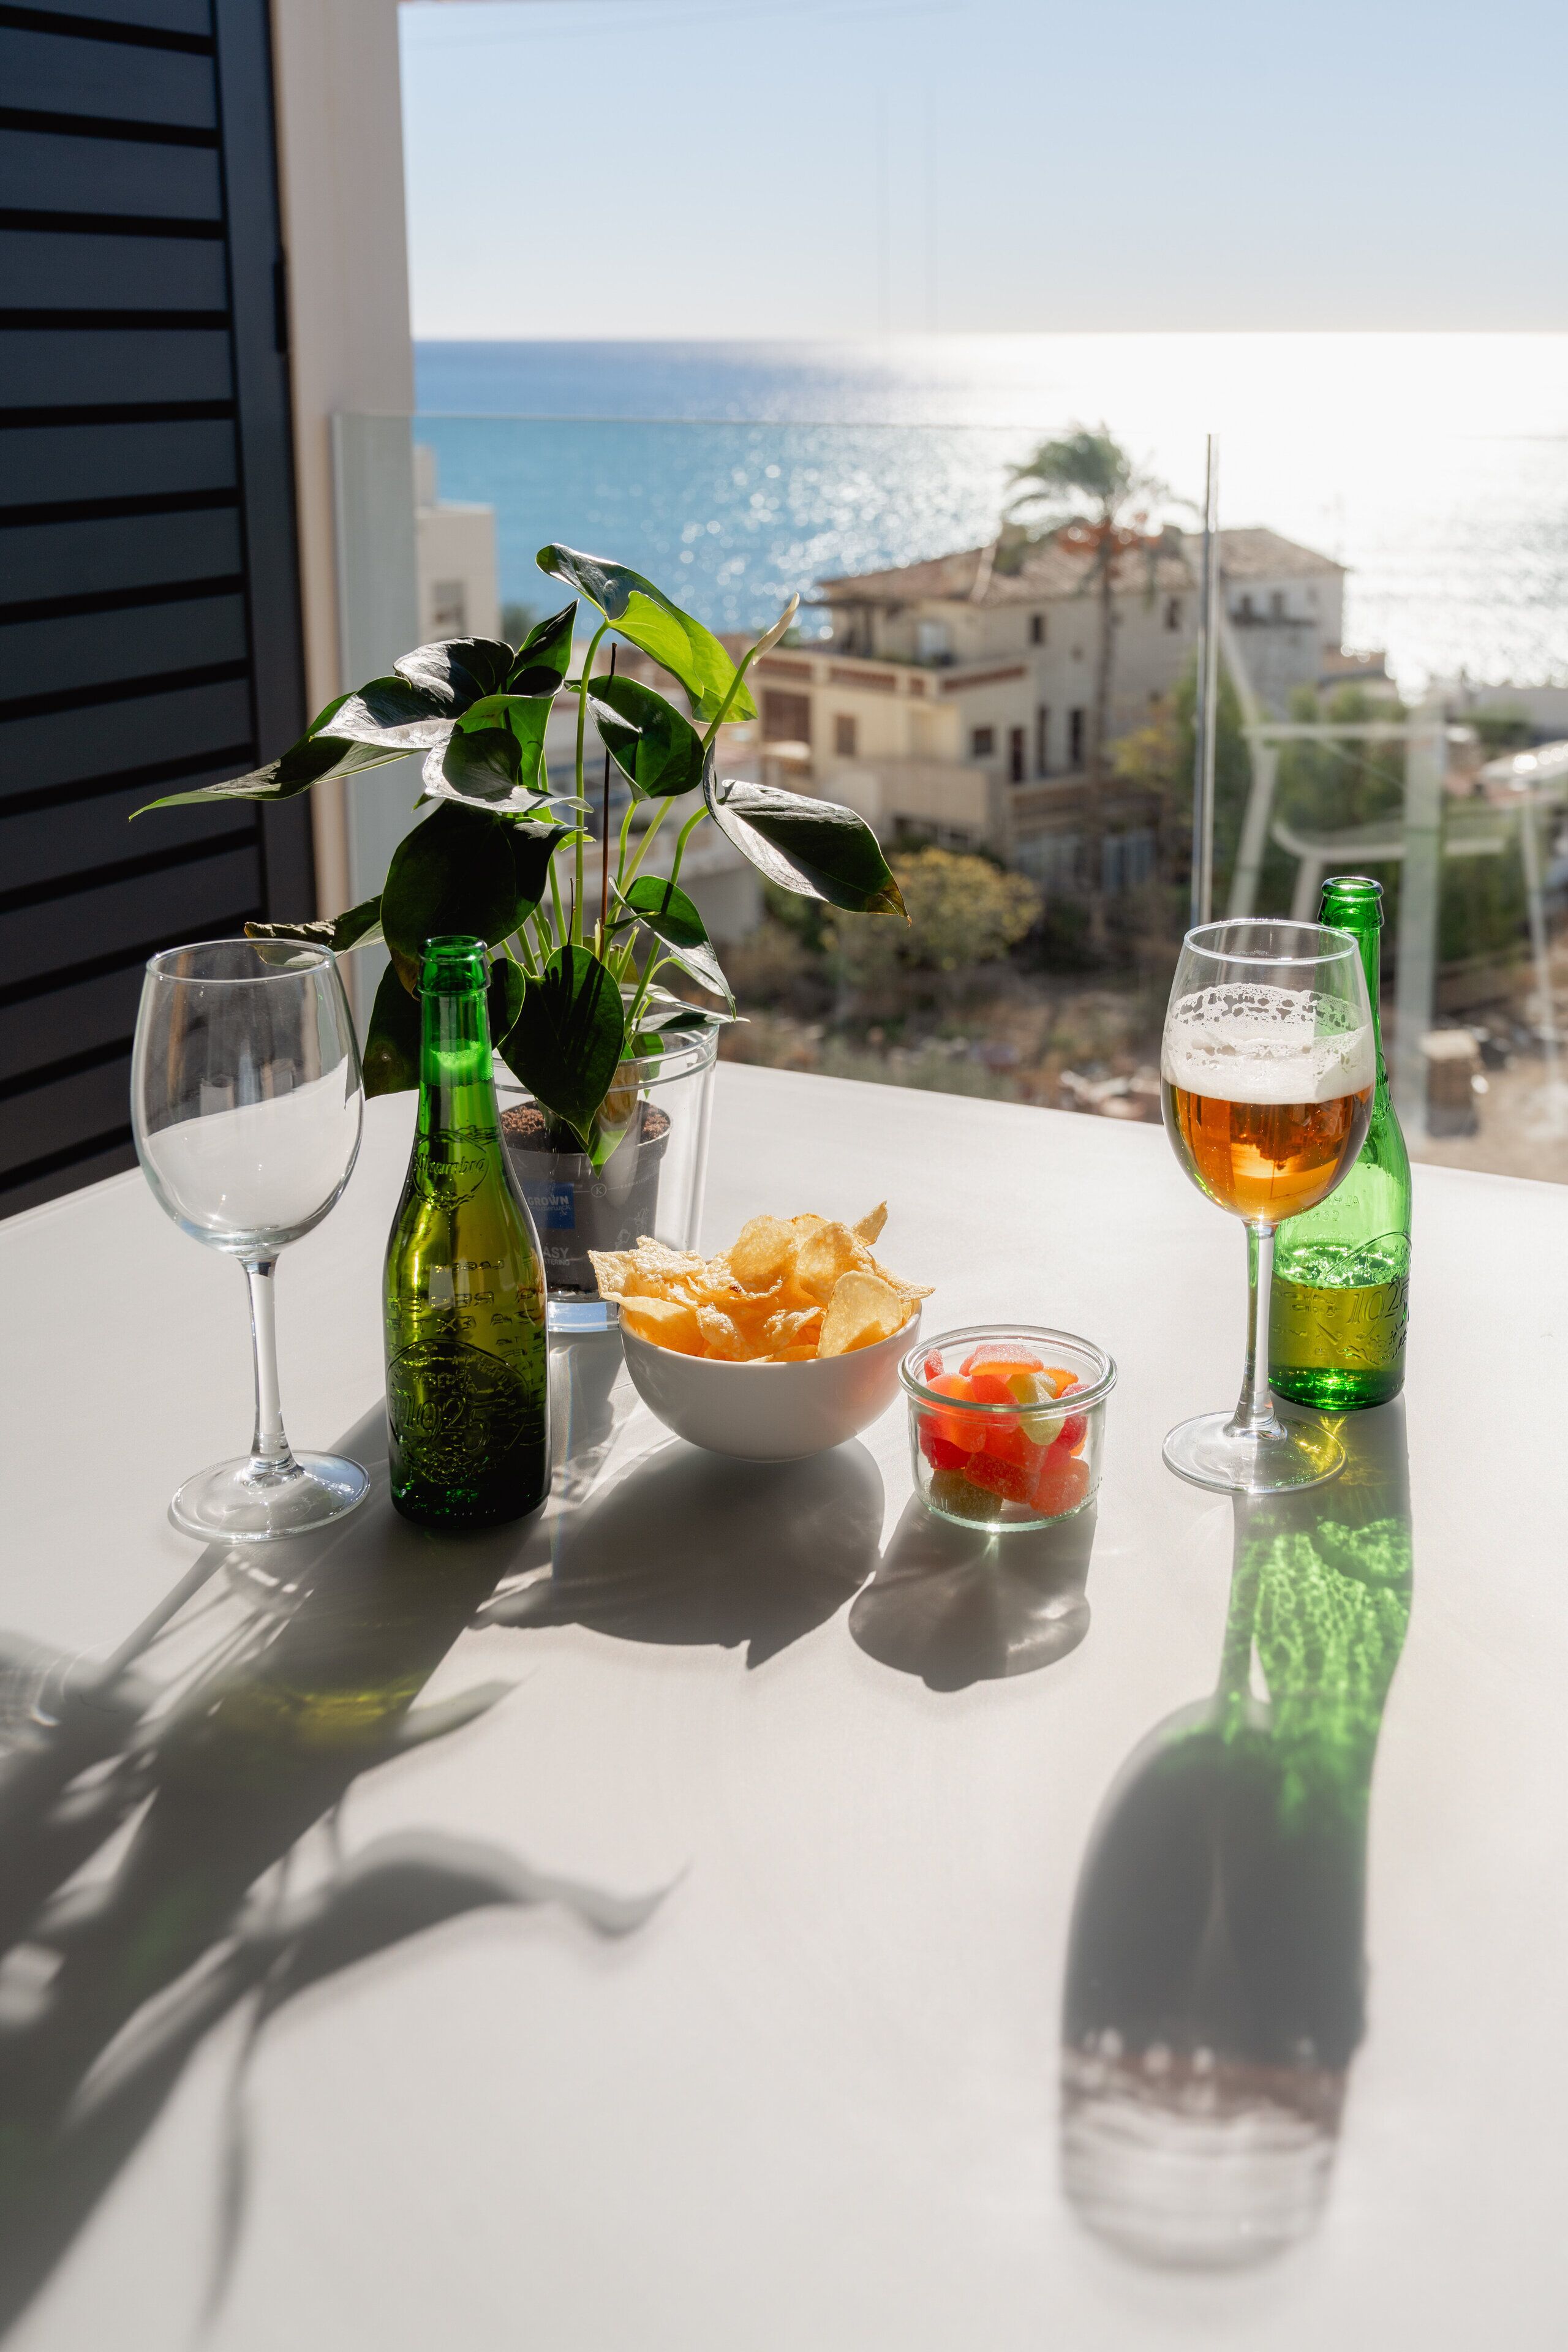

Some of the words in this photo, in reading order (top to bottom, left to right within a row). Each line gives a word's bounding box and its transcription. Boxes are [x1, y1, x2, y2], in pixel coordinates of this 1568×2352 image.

[527, 1195, 570, 1206] GROWN
[543, 1246, 570, 1259] ASY
[1346, 1279, 1409, 1339] 1925
[404, 1395, 491, 1453] 1925
